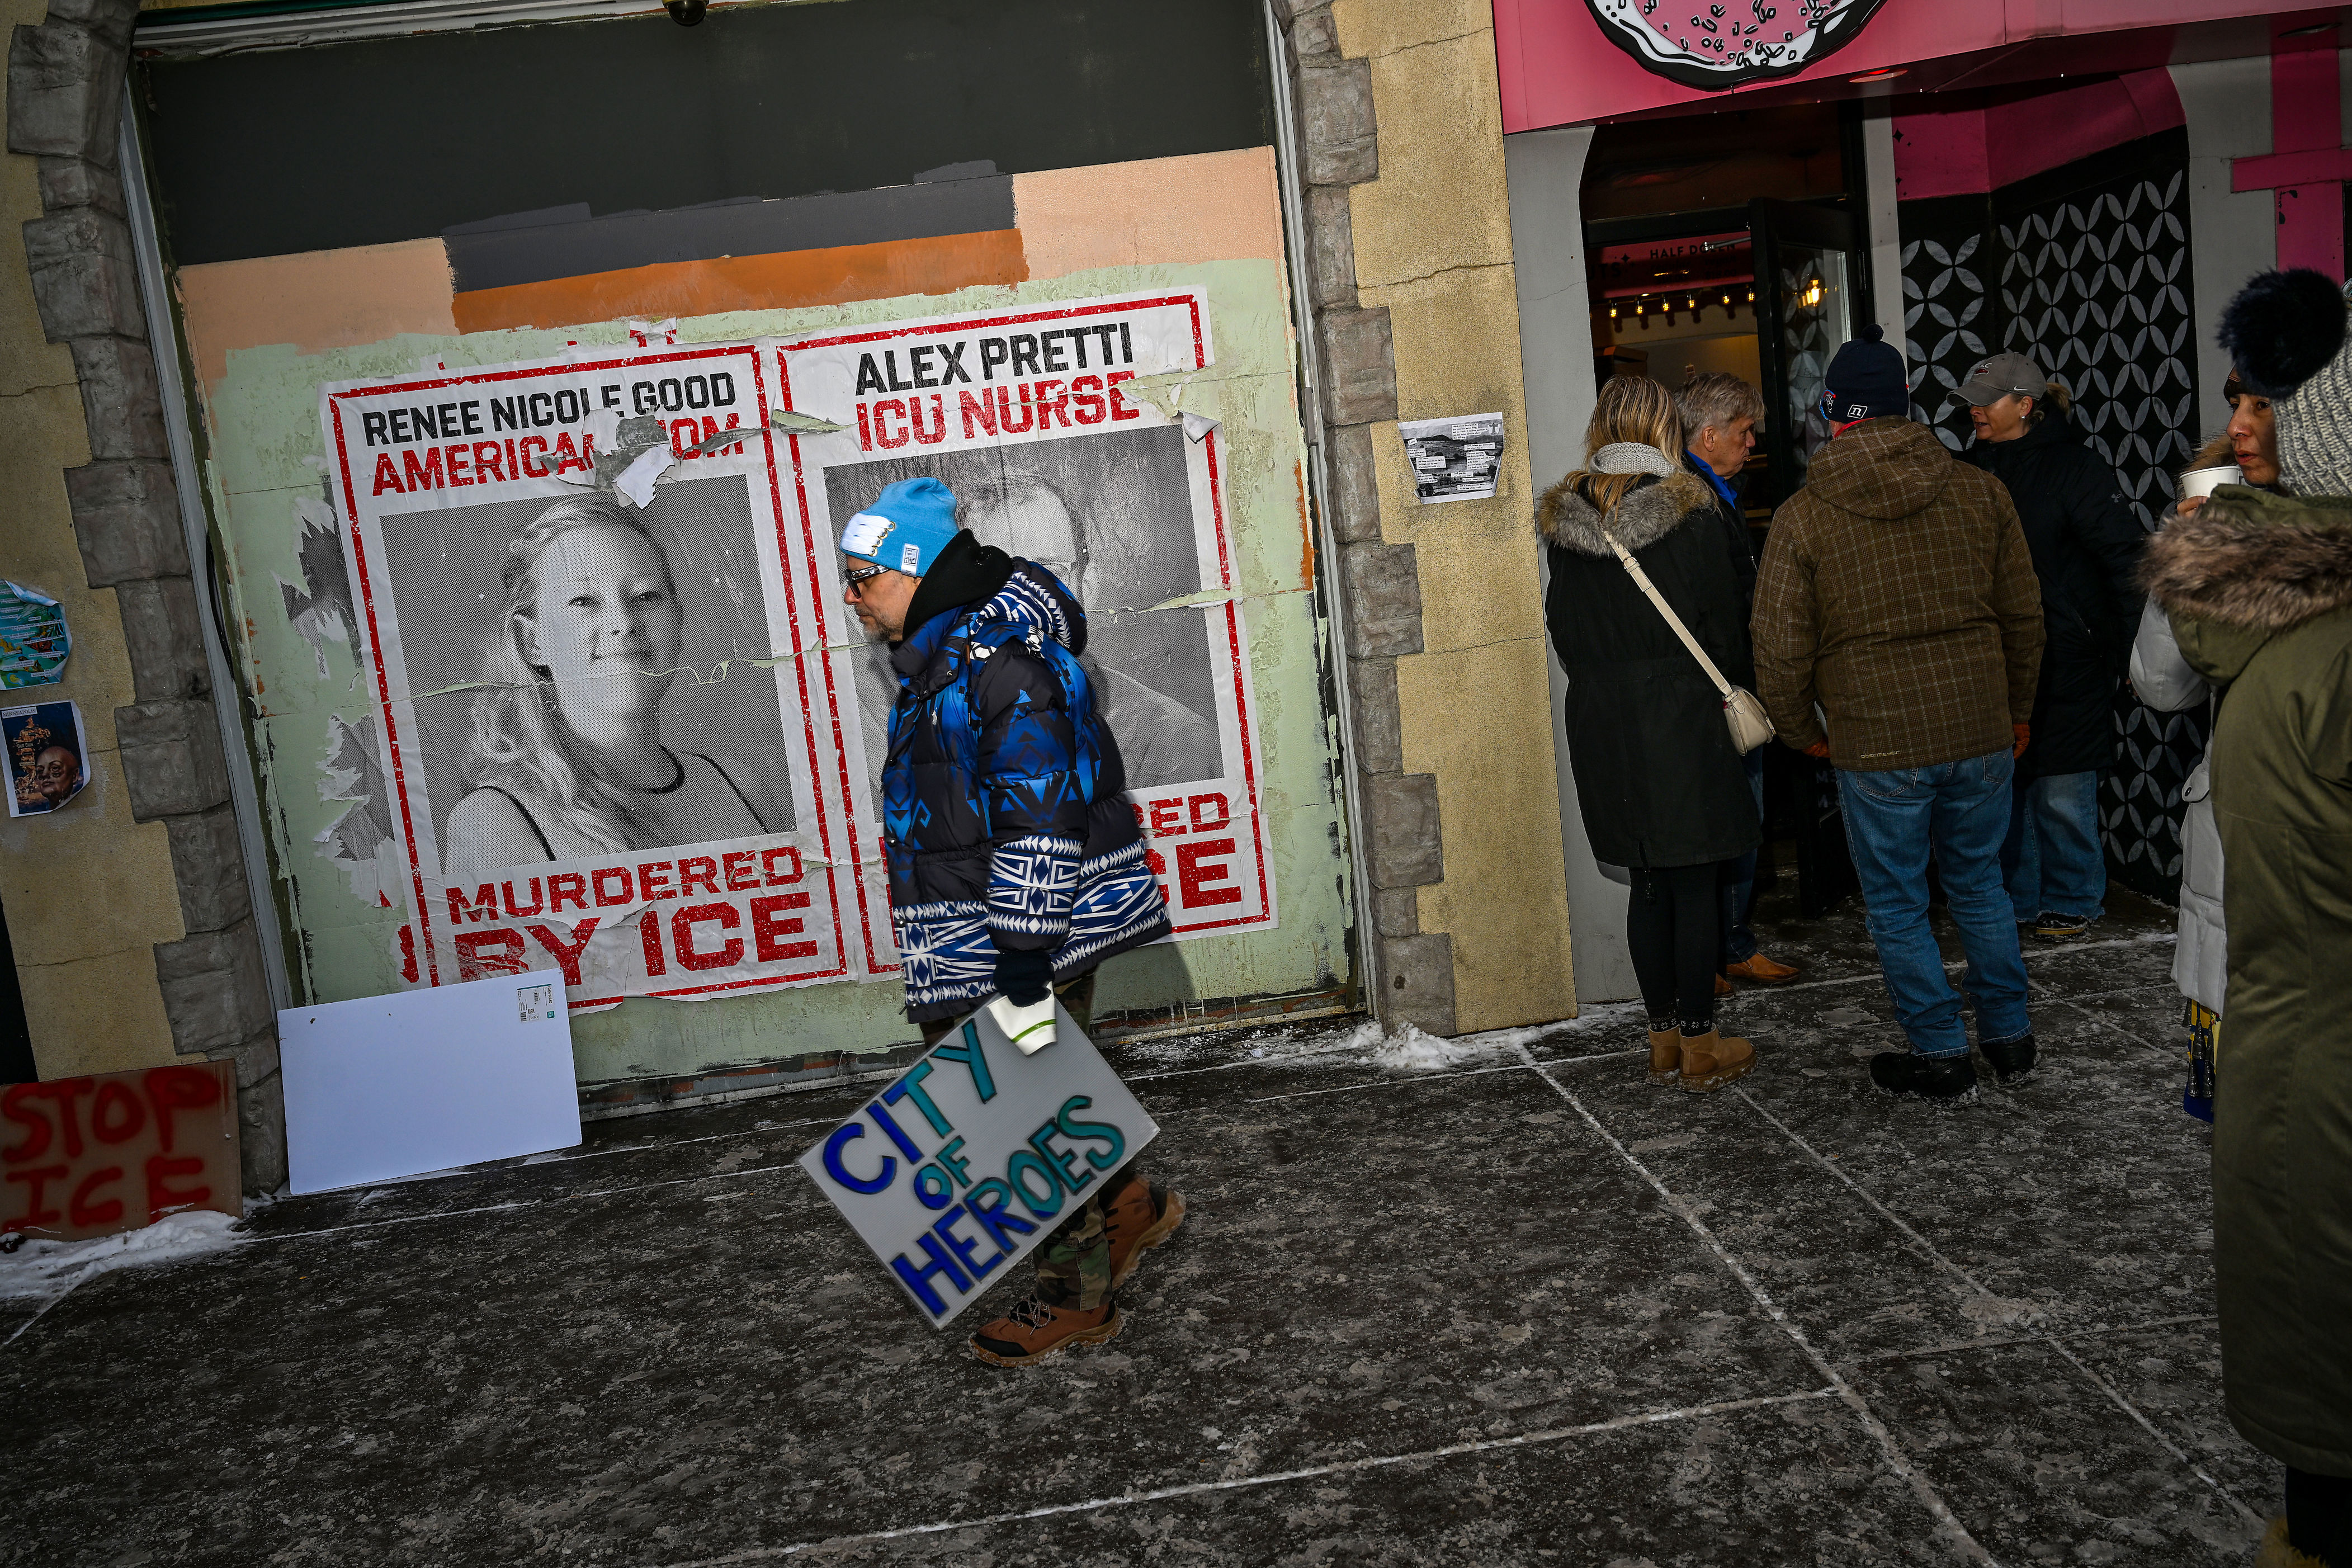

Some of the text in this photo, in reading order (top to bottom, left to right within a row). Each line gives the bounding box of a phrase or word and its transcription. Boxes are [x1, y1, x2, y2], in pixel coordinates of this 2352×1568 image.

[1650, 246, 1684, 260] HALF
[855, 322, 1133, 396] ALEX PRETTI
[362, 372, 736, 447] RENEE NICOLE GOOD
[657, 413, 744, 461] OM
[856, 370, 1140, 451] ICU NURSE
[3, 709, 36, 717] MINNEAPOLIS
[446, 846, 805, 925] MURDERED
[640, 891, 819, 977] ICE
[1, 1066, 221, 1163] STOP
[823, 1018, 997, 1194] CITY
[1, 1156, 215, 1230] ICE
[891, 1095, 1126, 1317] HEROES
[914, 1135, 971, 1210] OF
